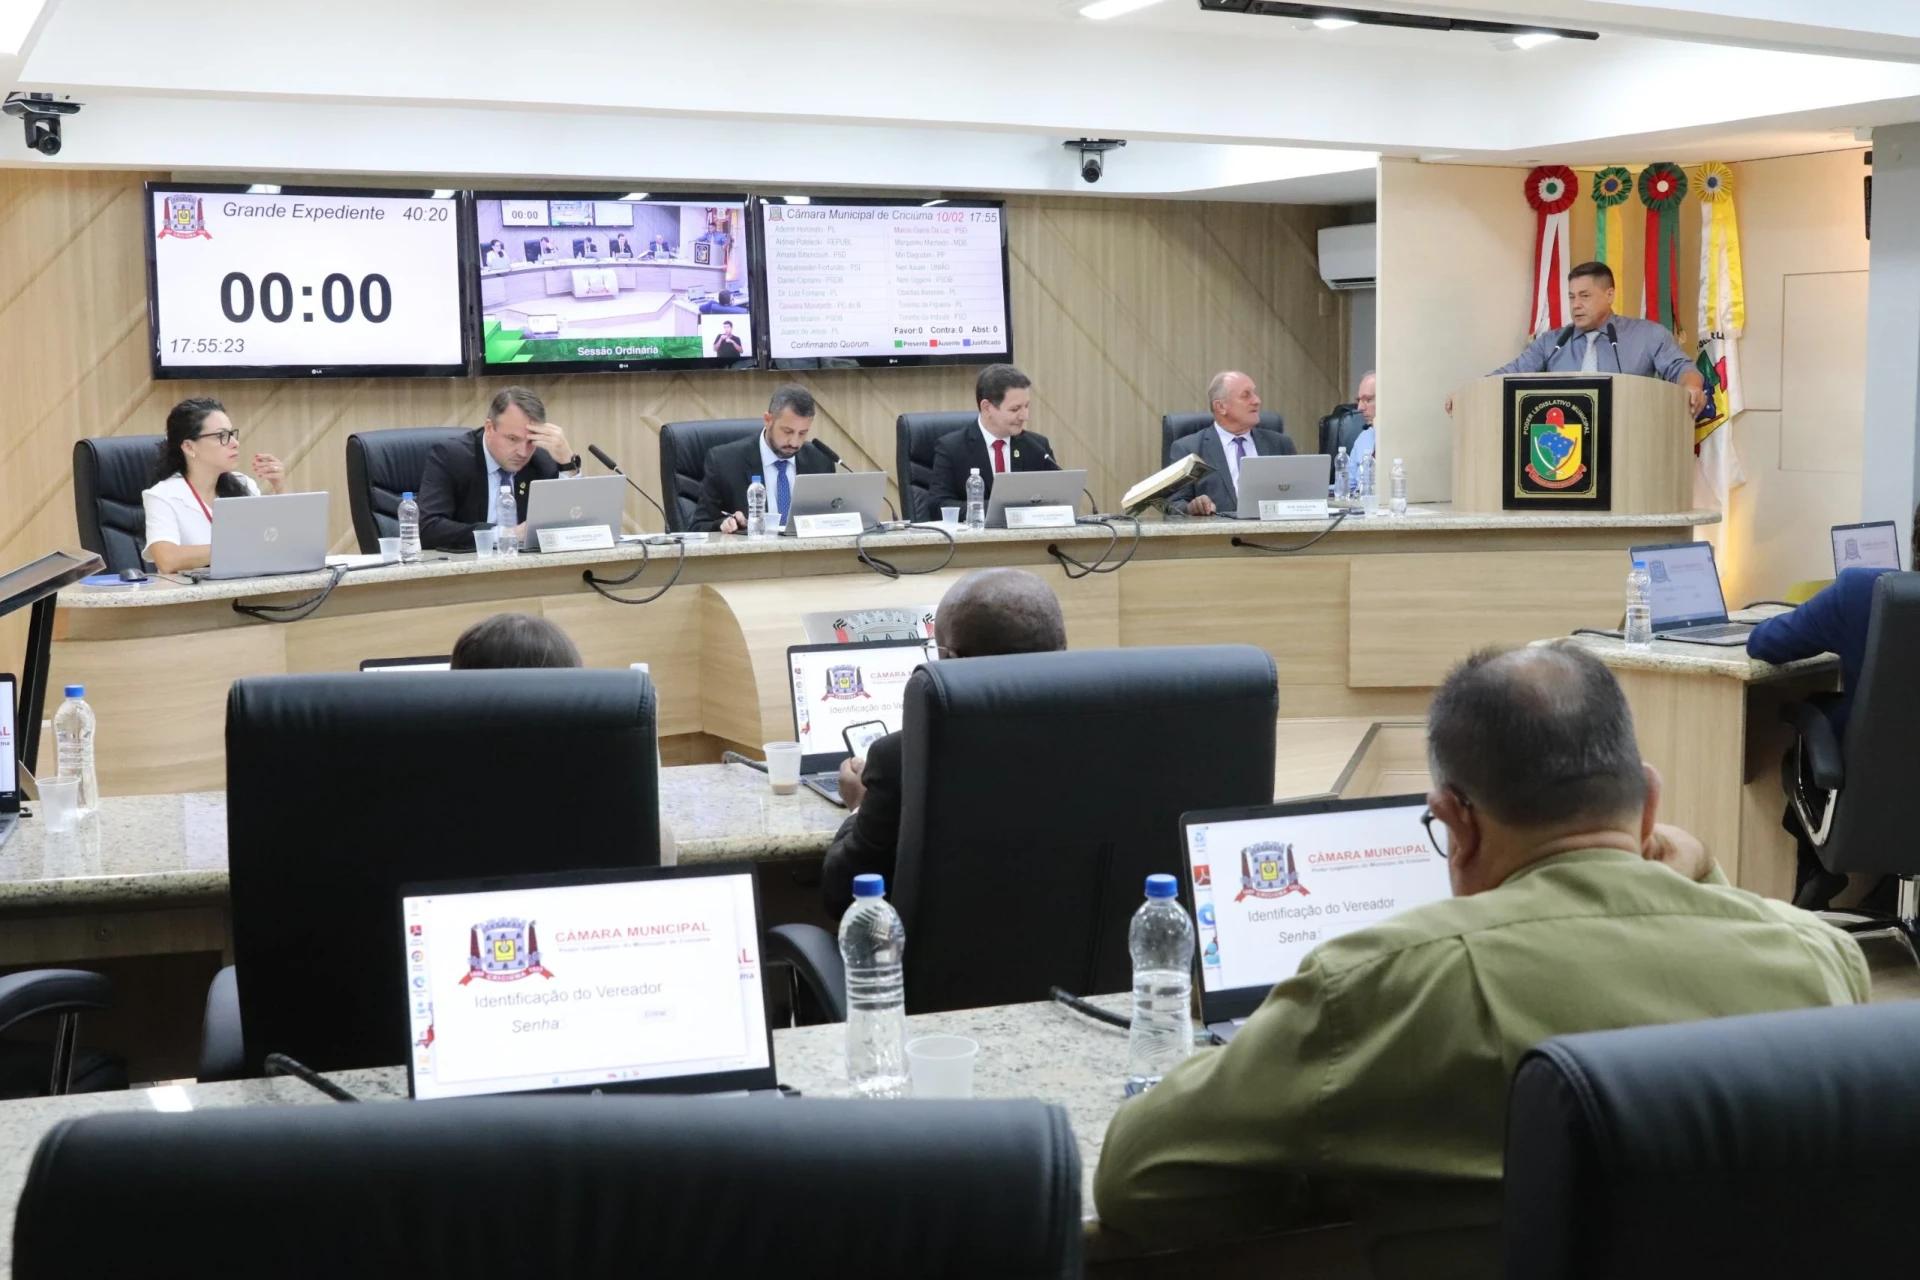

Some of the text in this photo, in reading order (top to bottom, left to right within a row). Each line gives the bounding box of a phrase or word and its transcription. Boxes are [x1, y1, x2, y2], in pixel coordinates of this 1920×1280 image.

[223, 202, 385, 221] Grande Expediente
[403, 207, 449, 222] 40:20
[787, 208, 826, 219] Câmara
[829, 209, 875, 221] Municipal
[877, 210, 889, 219] de
[937, 212, 964, 222] 10/02
[970, 212, 997, 222] 17:55
[220, 271, 392, 324] 00:00
[170, 338, 245, 353] 17:55:23
[577, 346, 659, 356] Sessão Ordinária
[790, 341, 838, 349] Confirmando
[1523, 399, 1590, 435] PODER LEGISLATIVO MUNICIPAL
[1308, 844, 1430, 864] CÂMARA MUNICIPAL
[1248, 897, 1395, 923] Identificação do Vereador
[555, 922, 710, 943] CÂMARA MUNICIPAL
[475, 982, 663, 1008] Identificação do Vereador
